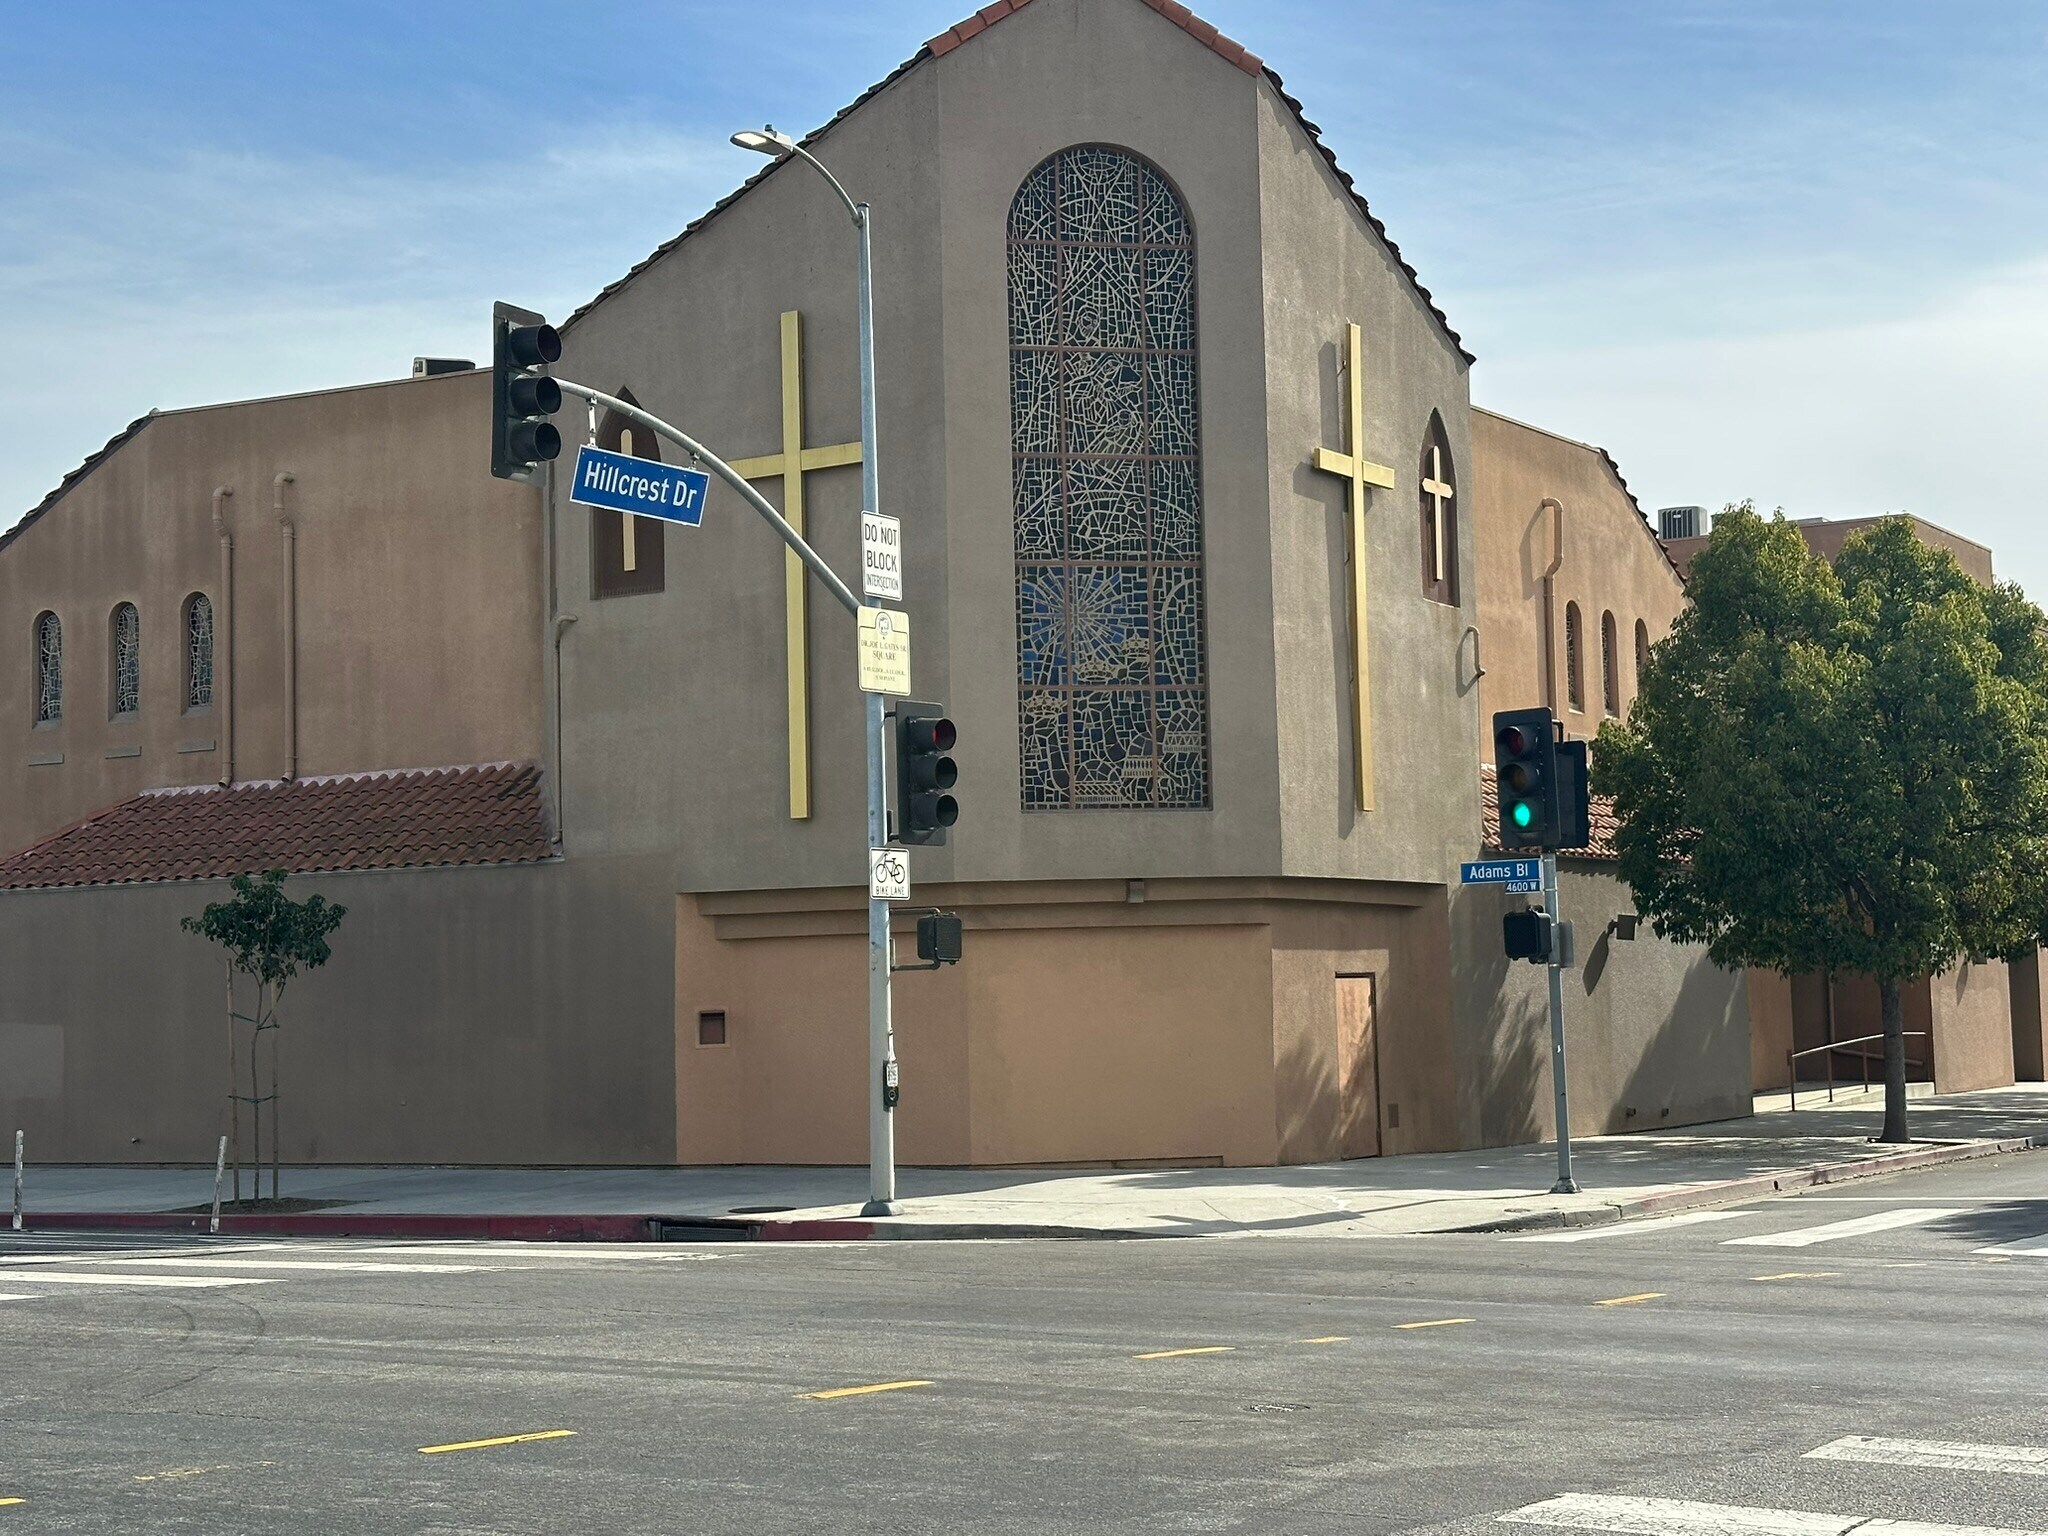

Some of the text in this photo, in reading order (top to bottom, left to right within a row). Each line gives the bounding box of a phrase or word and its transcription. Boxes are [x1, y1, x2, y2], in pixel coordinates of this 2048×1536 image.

[583, 460, 698, 509] Hillcrest Dr
[864, 524, 897, 546] DO NOT
[866, 550, 898, 572] BLOCK
[866, 574, 898, 590] INTERSECTION
[872, 650, 896, 660] SQUARE
[1470, 862, 1528, 879] Adams Bl
[876, 886, 904, 895] BIKE LANE
[1506, 881, 1537, 892] 4600 W
